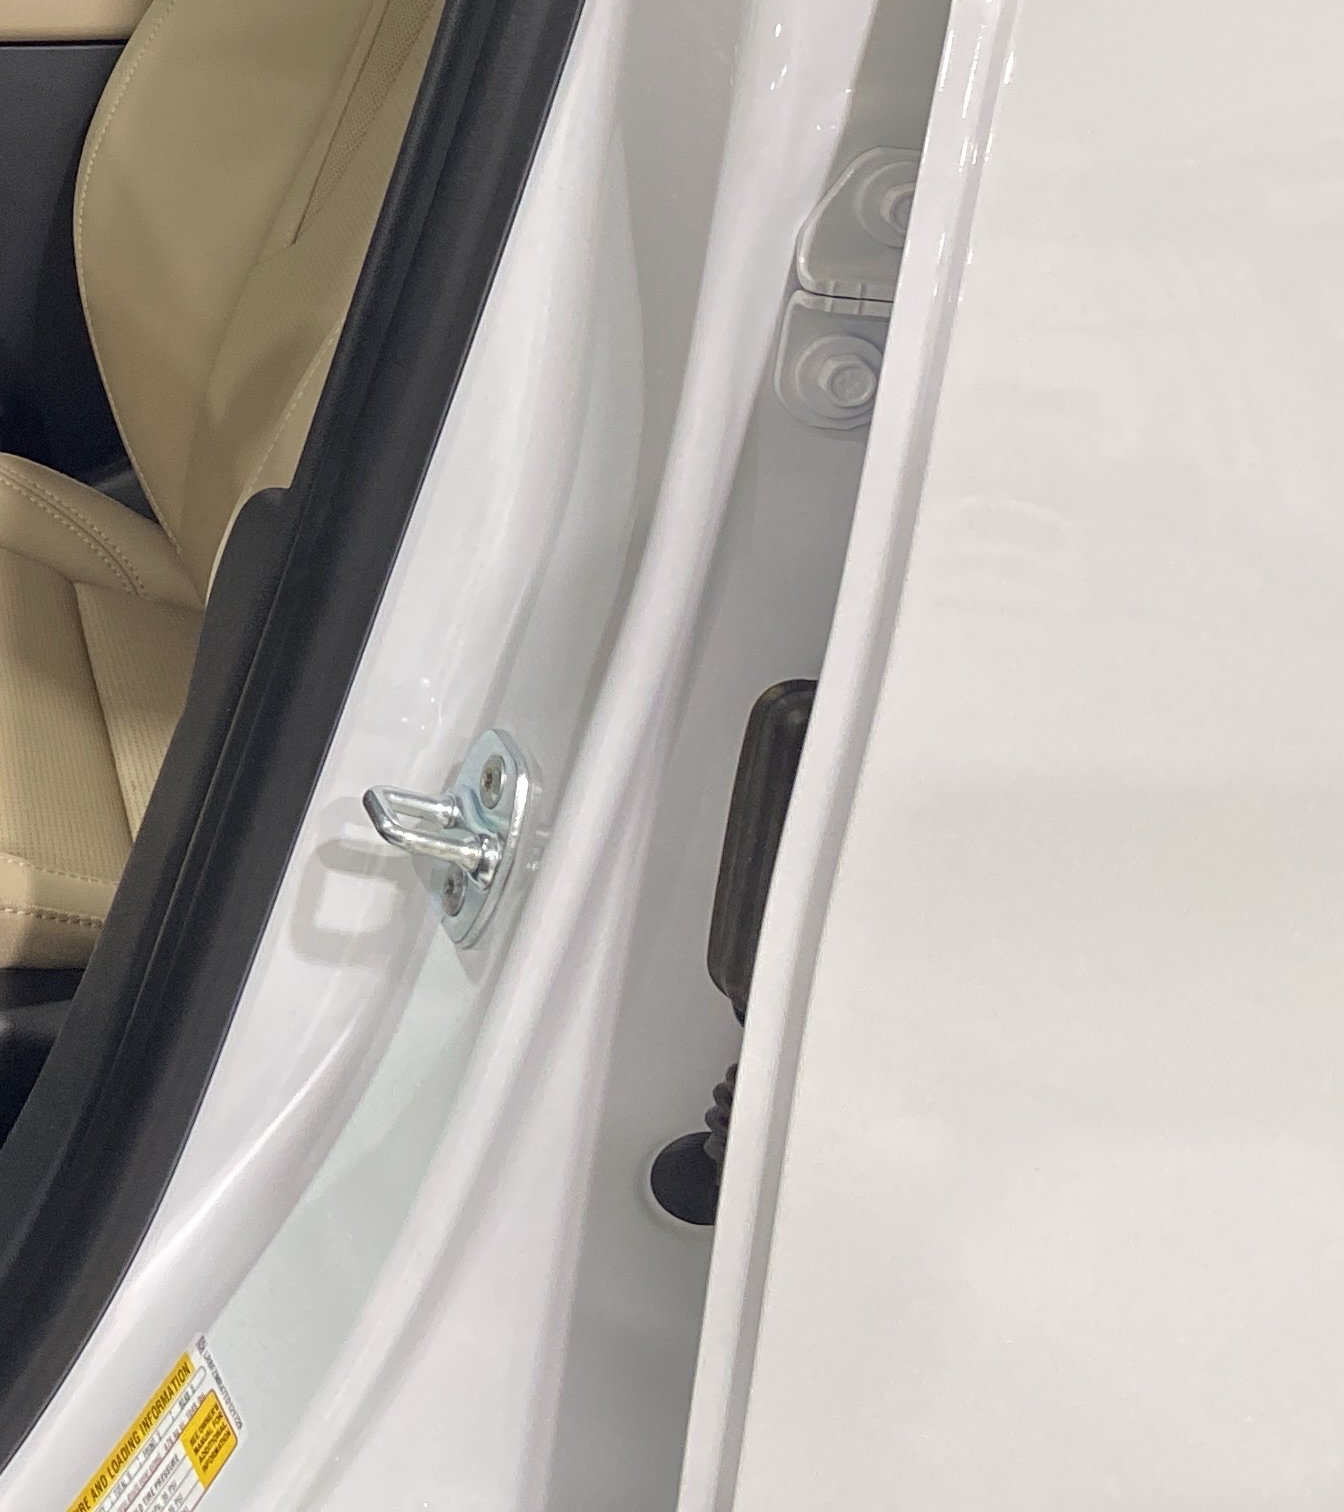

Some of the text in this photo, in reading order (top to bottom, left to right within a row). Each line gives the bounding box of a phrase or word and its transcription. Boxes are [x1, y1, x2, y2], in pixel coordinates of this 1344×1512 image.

[90, 1474, 108, 1503] AND
[107, 1431, 141, 1480] LOADING
[140, 1362, 191, 1436] INFORMATION
